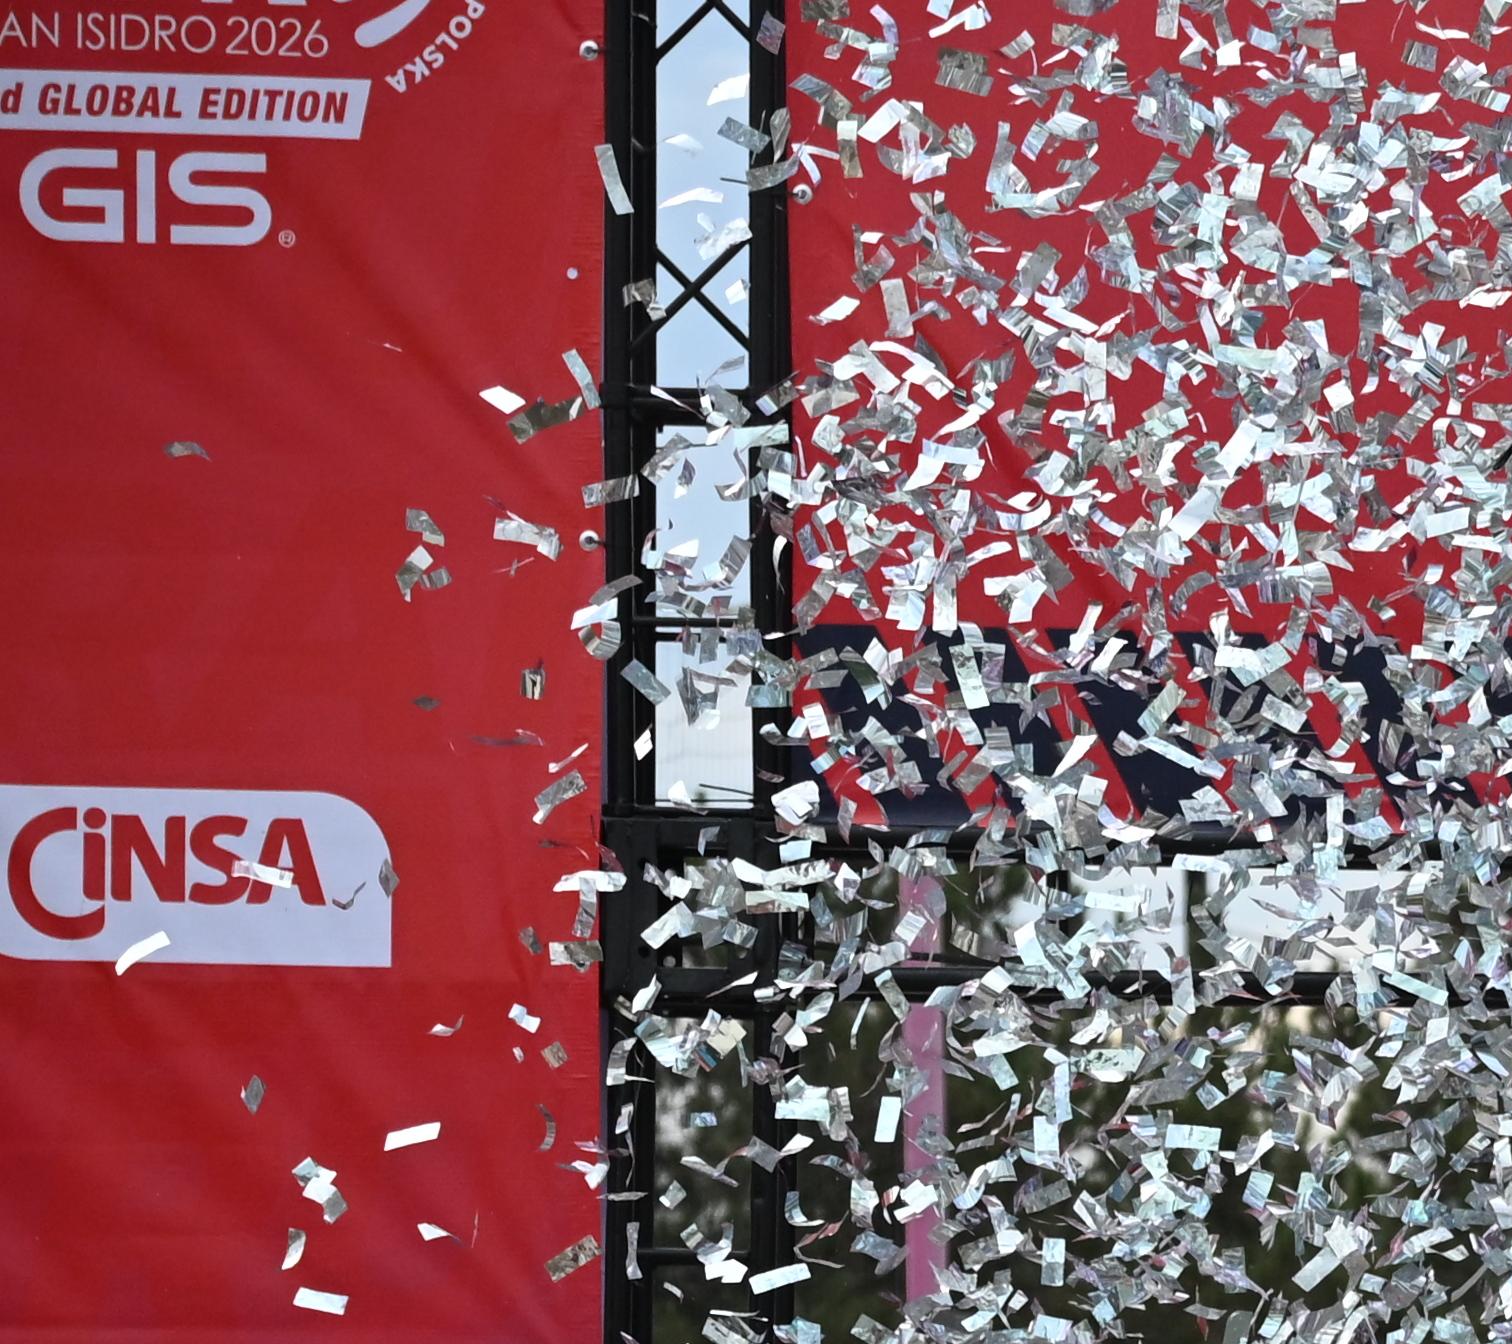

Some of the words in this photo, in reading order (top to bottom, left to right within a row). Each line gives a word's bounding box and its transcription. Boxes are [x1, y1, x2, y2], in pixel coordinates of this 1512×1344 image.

[77, 12, 217, 54] ISIDRO
[225, 18, 330, 58] 2026
[384, 0, 486, 94] POLSKA
[38, 83, 183, 119] GLOBAL
[197, 87, 349, 125] EDITION
[18, 147, 273, 247] GIS
